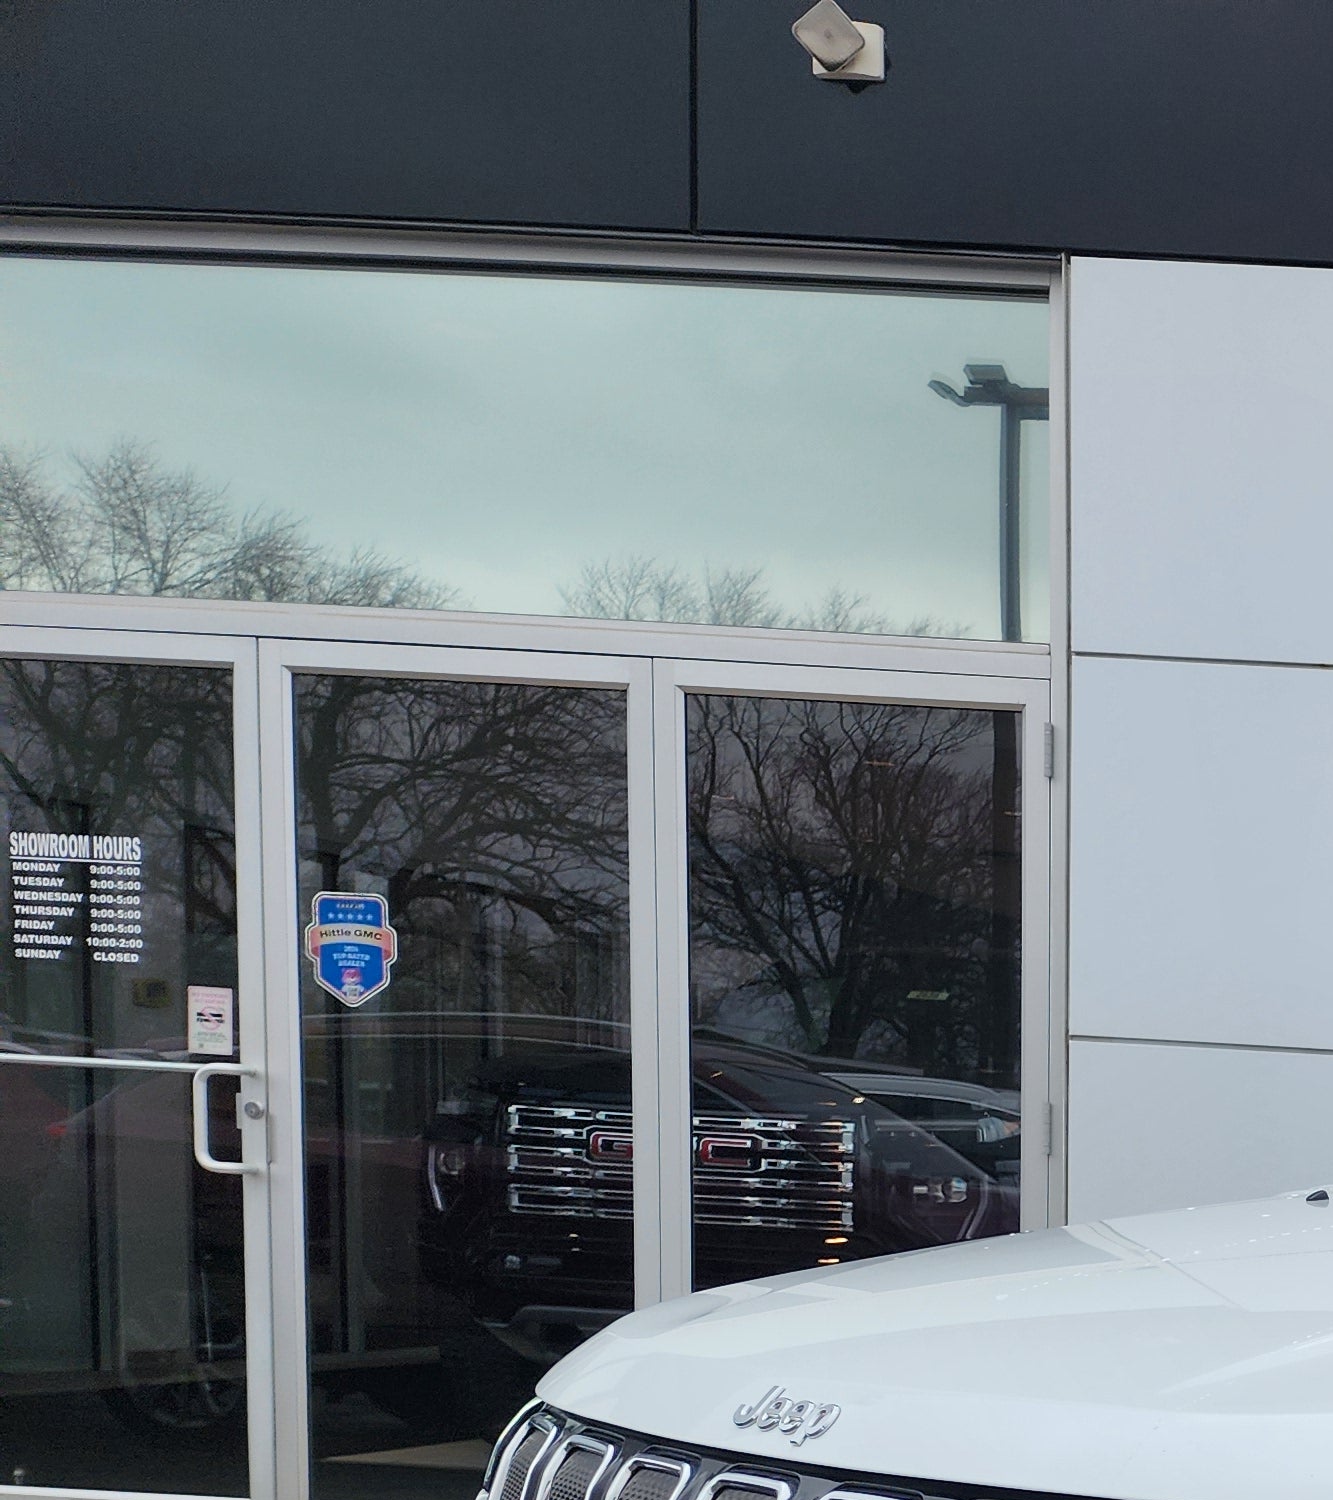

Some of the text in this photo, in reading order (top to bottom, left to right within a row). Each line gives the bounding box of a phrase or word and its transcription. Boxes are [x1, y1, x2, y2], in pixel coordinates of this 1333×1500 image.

[10, 832, 141, 860] SHOWROOM HOURS
[12, 862, 60, 872] MONDAY
[12, 876, 65, 887] TUESDAY
[14, 890, 83, 902] WEDNESDAY
[13, 905, 75, 916] THURSDAY
[14, 920, 55, 930] FRIDAY
[13, 934, 73, 945] SATURDAY
[320, 929, 382, 940] Hittle GMC
[15, 948, 139, 962] SUNDAY CLOSED
[590, 1131, 752, 1167] GC
[733, 1385, 841, 1447] Jeep
